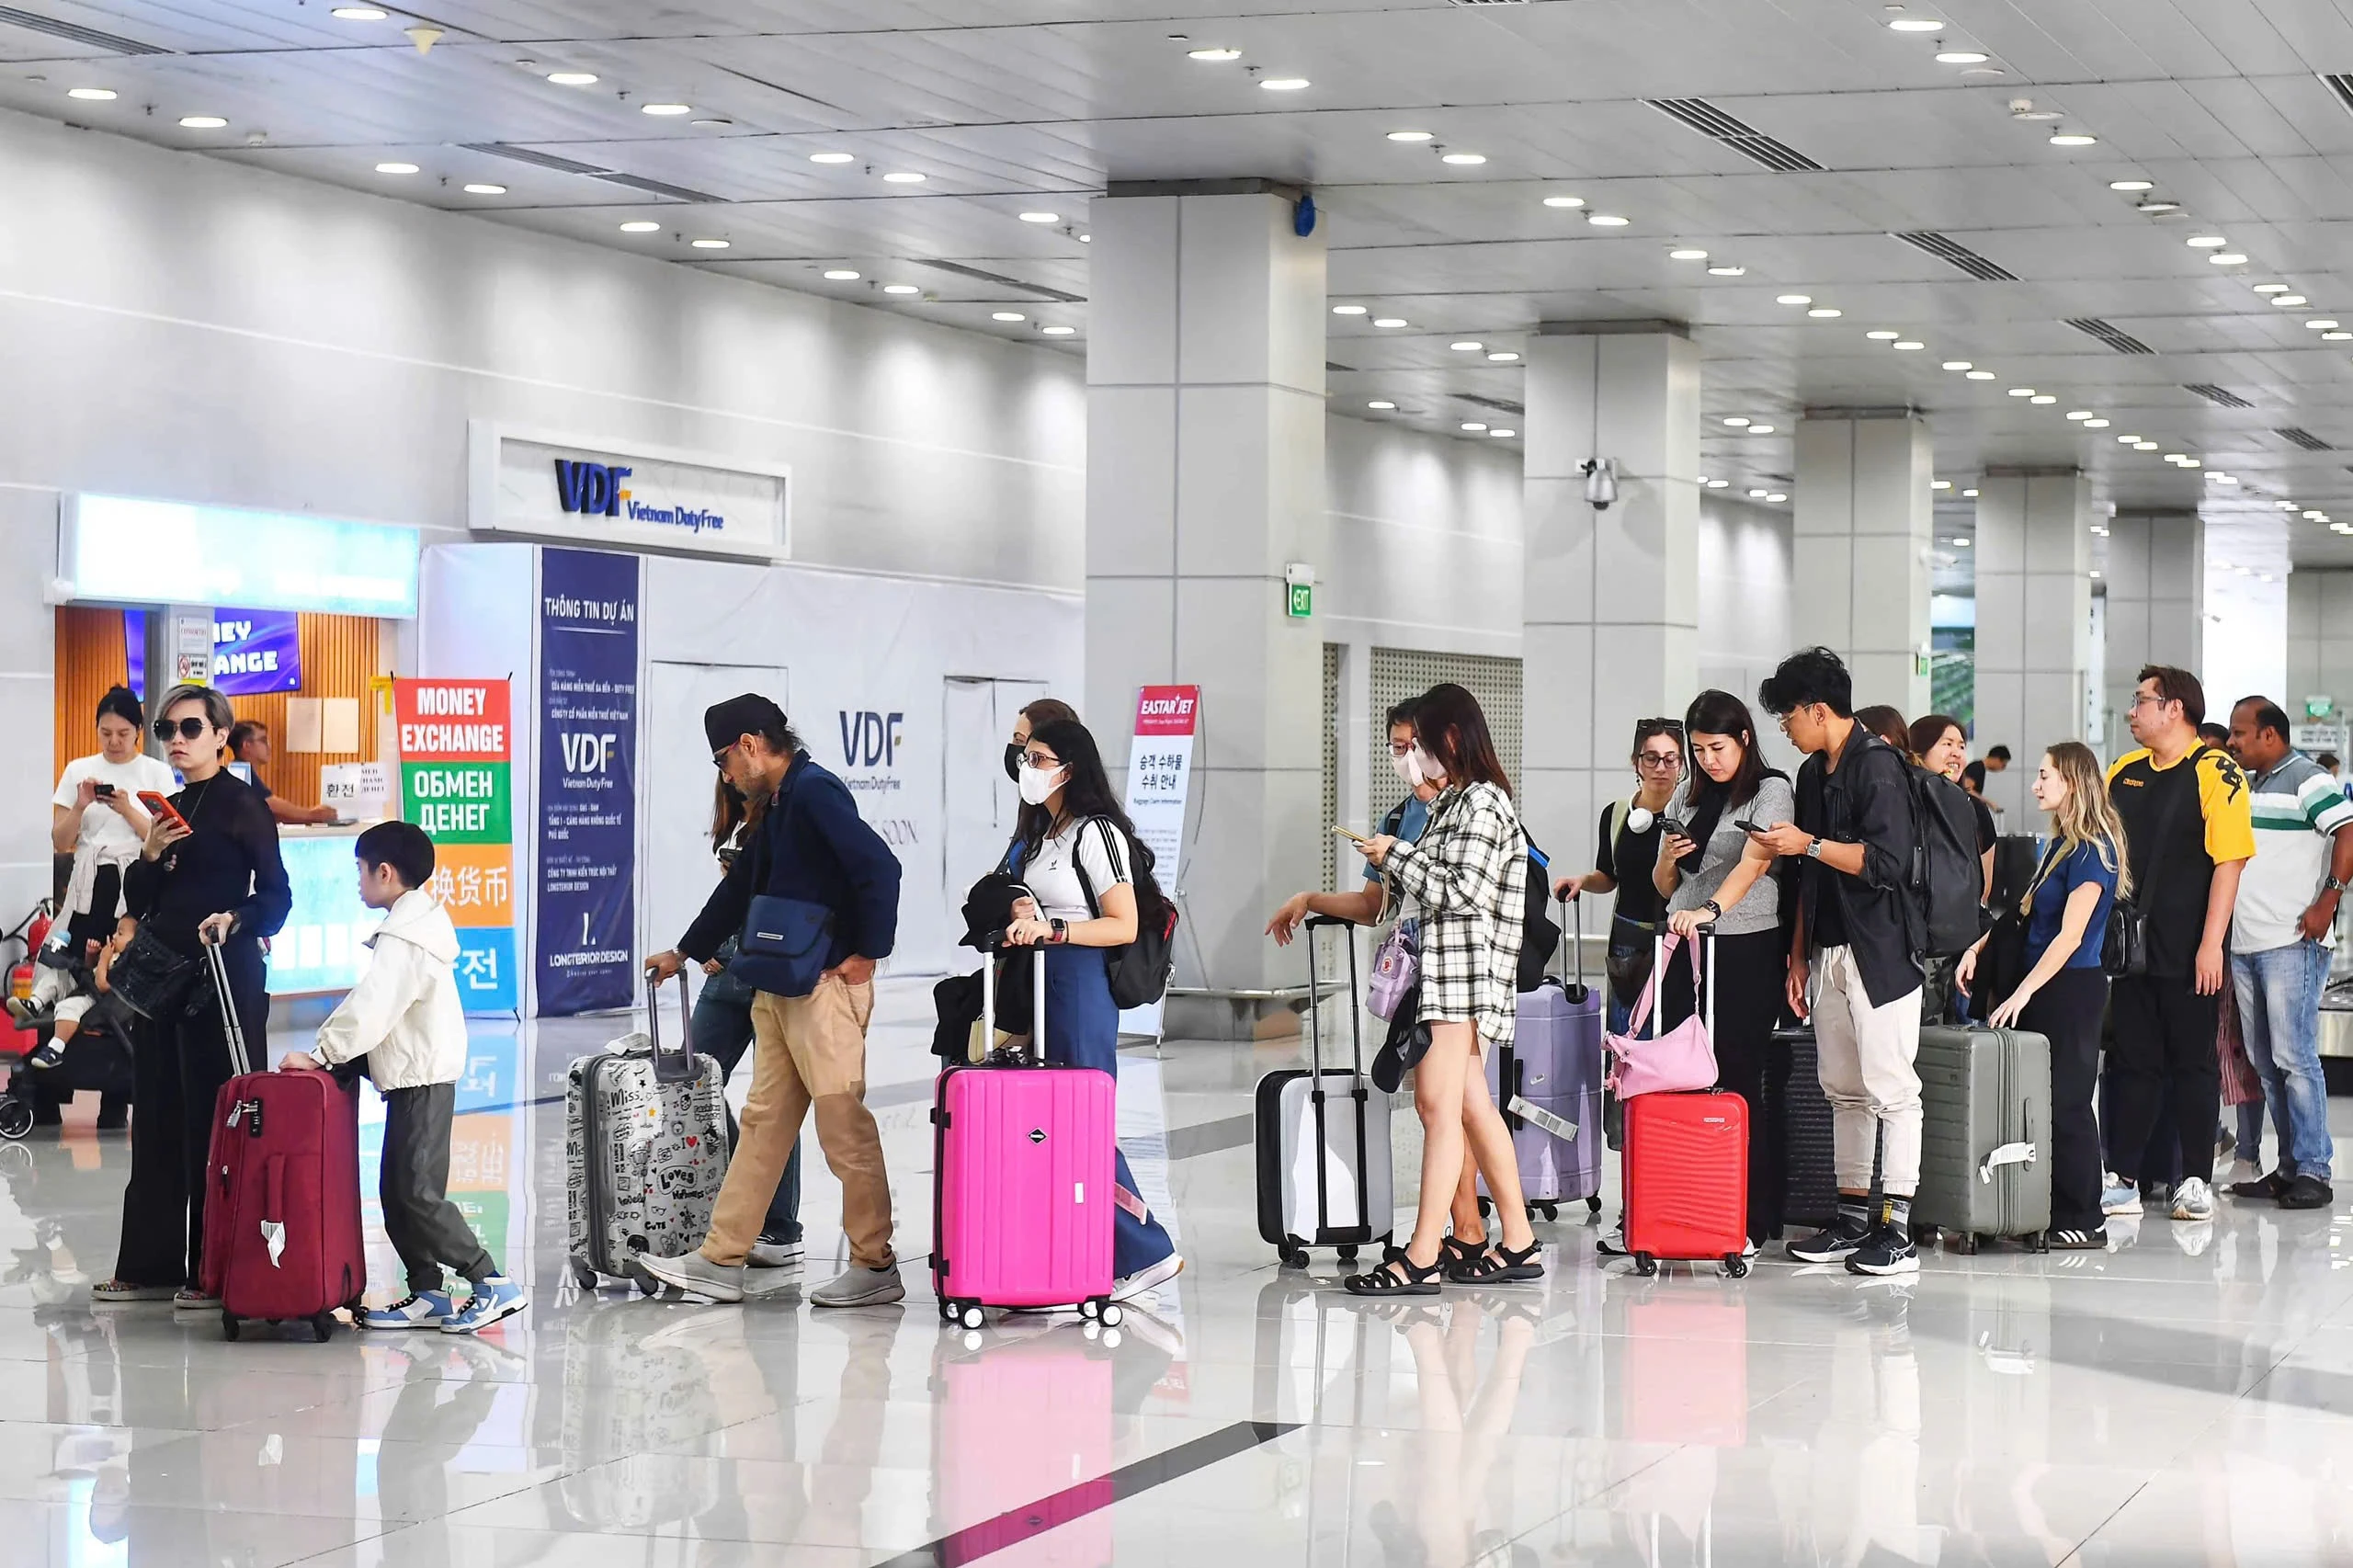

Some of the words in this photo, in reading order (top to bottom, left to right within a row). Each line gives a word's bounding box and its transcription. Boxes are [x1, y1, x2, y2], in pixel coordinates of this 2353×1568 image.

[554, 459, 632, 517] VDF
[628, 500, 675, 527] Vietnam
[544, 593, 581, 619] THÔNG
[583, 599, 599, 619] TIN
[602, 600, 618, 626] DỰ
[620, 598, 634, 622] ÁN
[214, 650, 278, 676] ANGE
[416, 687, 487, 716] MONEY
[1141, 699, 1177, 715] EASTAR
[1176, 699, 1195, 715] JET
[401, 723, 505, 753] EXCHANGE
[561, 732, 617, 773] VDF
[839, 710, 904, 767] VDF
[1140, 754, 1156, 770] 승객
[1158, 754, 1183, 771] 수하물
[326, 782, 355, 799] 환전
[414, 769, 494, 798] ОБМЕН
[563, 777, 586, 790] Vietnam
[1160, 774, 1176, 790] 안내
[419, 802, 491, 835] ДЕНЕГ
[431, 866, 507, 908] 换货币
[451, 947, 498, 990] 전
[550, 951, 600, 968] LONGTERIOR
[600, 949, 629, 964] DESIGN
[660, 1169, 695, 1190] Loves
